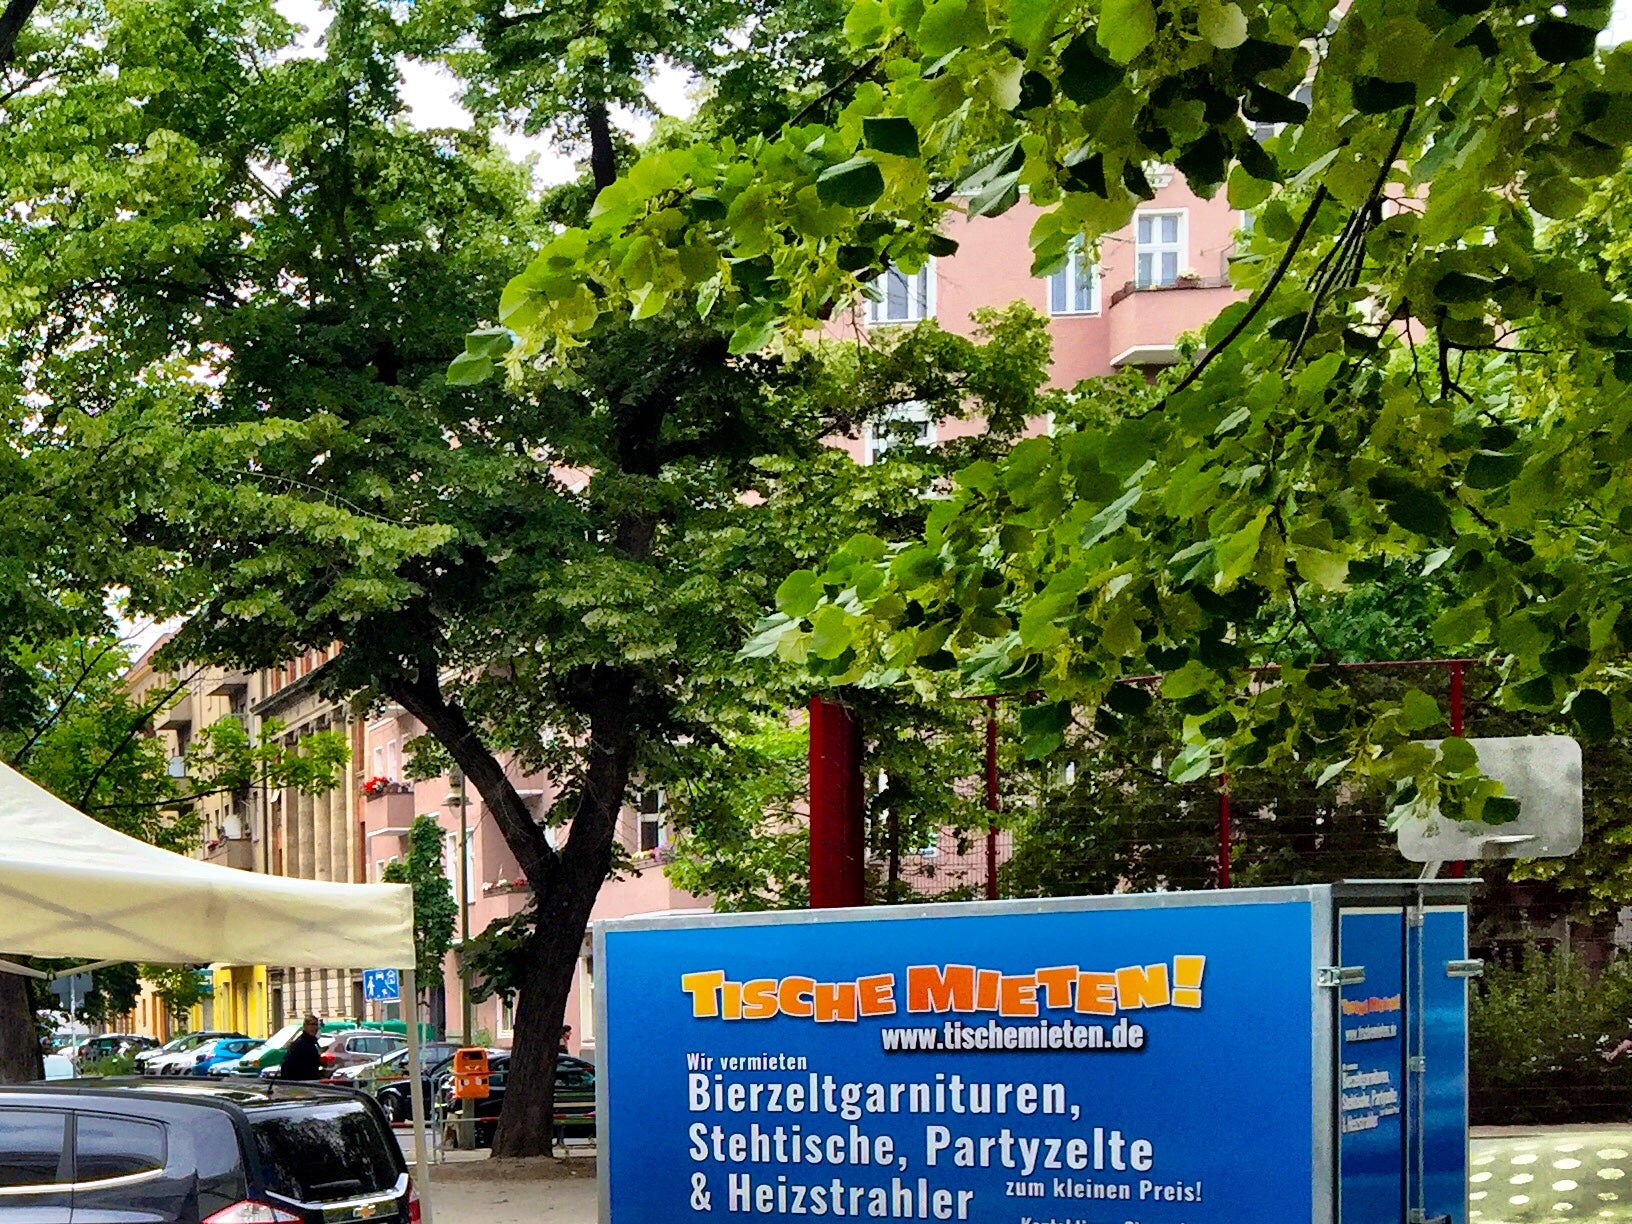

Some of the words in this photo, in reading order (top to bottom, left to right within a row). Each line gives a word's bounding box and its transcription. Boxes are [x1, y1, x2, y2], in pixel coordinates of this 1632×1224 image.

[881, 1018, 1144, 1050] www.tischemieten.de
[686, 1052, 714, 1071] Wir
[720, 1052, 807, 1071] vermieten
[688, 1072, 1080, 1121] Bierzeltgarnituren,
[689, 1122, 907, 1172] Stehtische,
[926, 1125, 1154, 1176] Partyzelte
[690, 1171, 712, 1211] &
[728, 1173, 974, 1220] Heizstrahler
[1006, 1181, 1045, 1197] zum
[1053, 1177, 1130, 1200] kleinen
[1139, 1179, 1202, 1203] Preis!
